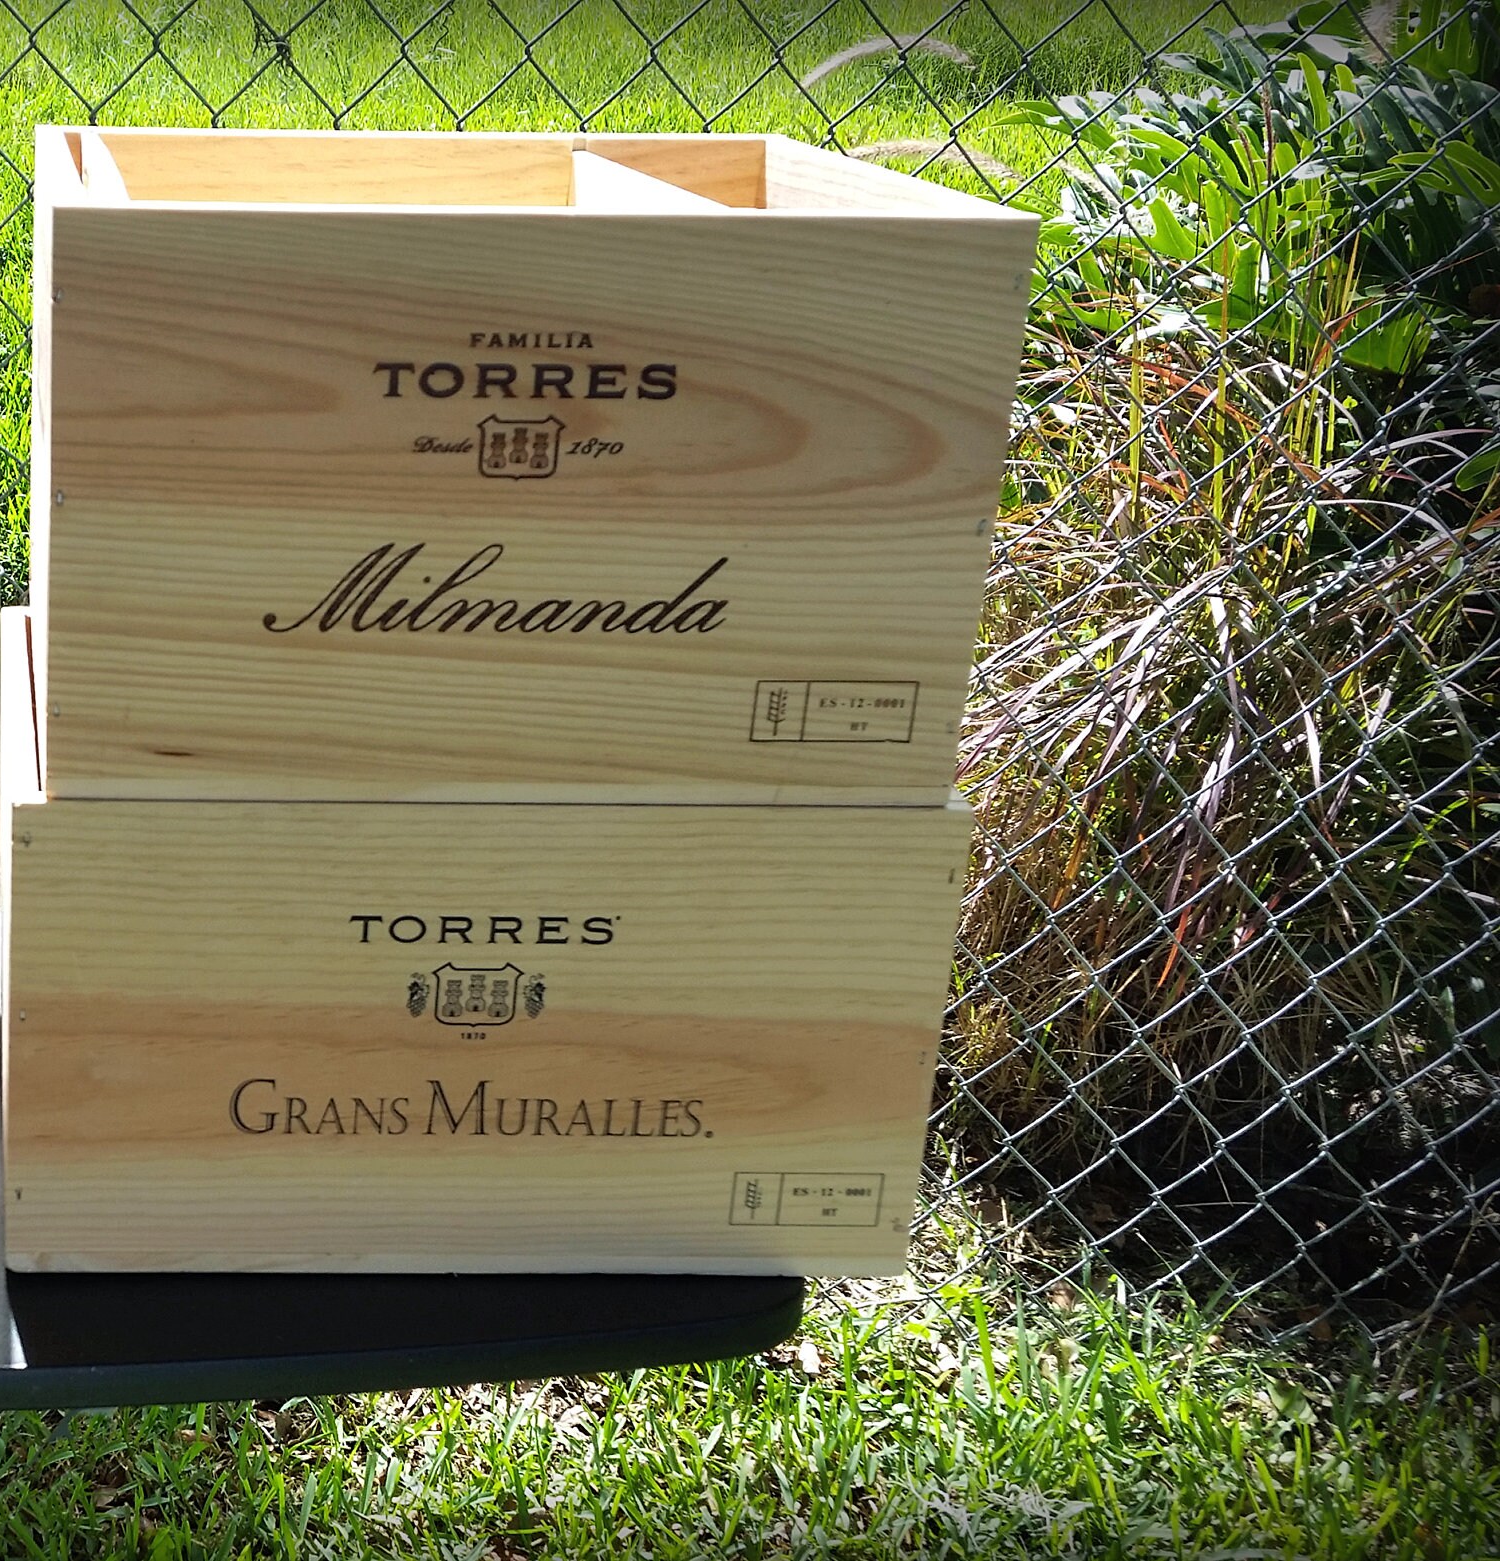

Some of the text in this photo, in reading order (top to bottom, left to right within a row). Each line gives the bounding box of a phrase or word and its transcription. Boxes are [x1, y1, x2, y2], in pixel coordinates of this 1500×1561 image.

[470, 332, 594, 349] FAMILIA
[372, 361, 678, 400] TORRES
[412, 434, 625, 459] Desde 1870
[262, 542, 730, 635] Milmanda
[229, 1077, 410, 1137] GRANS
